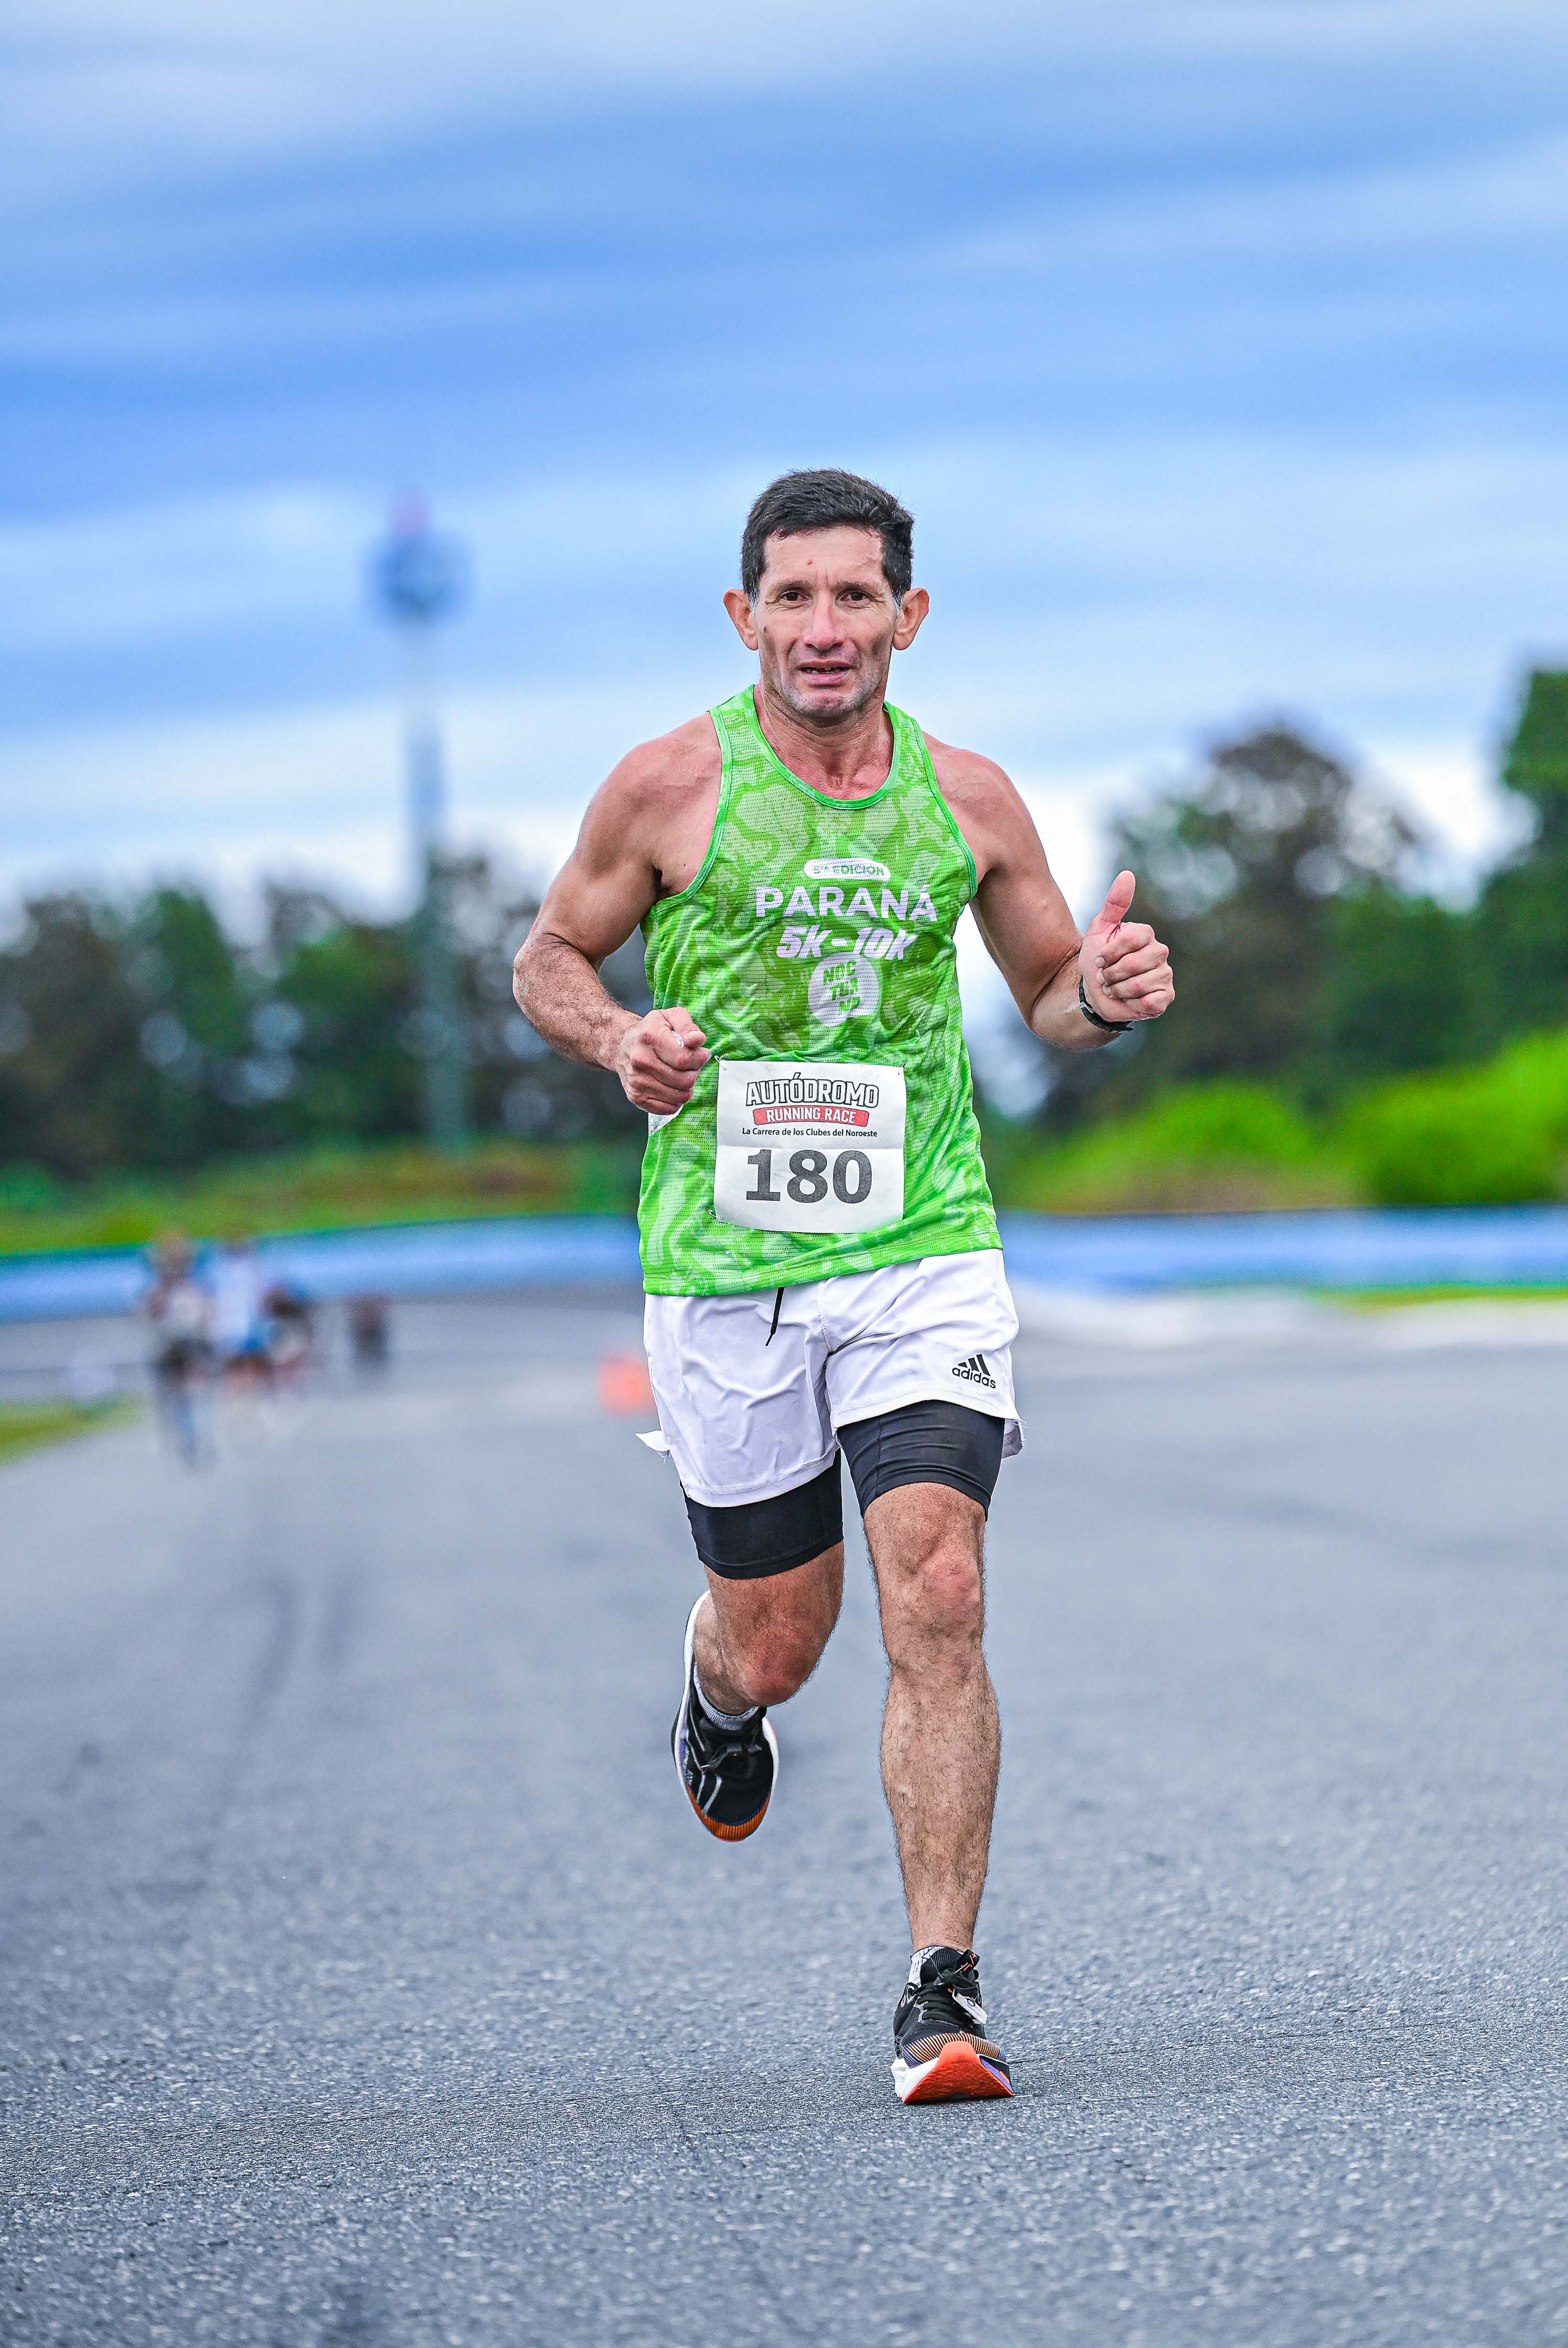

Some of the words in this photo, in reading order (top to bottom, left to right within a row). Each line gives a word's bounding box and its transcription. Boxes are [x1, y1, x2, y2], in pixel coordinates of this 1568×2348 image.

[832, 864, 884, 876] EDICIÓN
[755, 885, 937, 922] PARANÁ
[823, 960, 856, 985] NOC
[745, 1072, 879, 1108] AUTÓDROMO
[766, 1107, 820, 1123] RUNNING
[825, 1107, 856, 1124] RACE
[746, 1149, 872, 1204] 180
[952, 1367, 996, 1389] adidas
